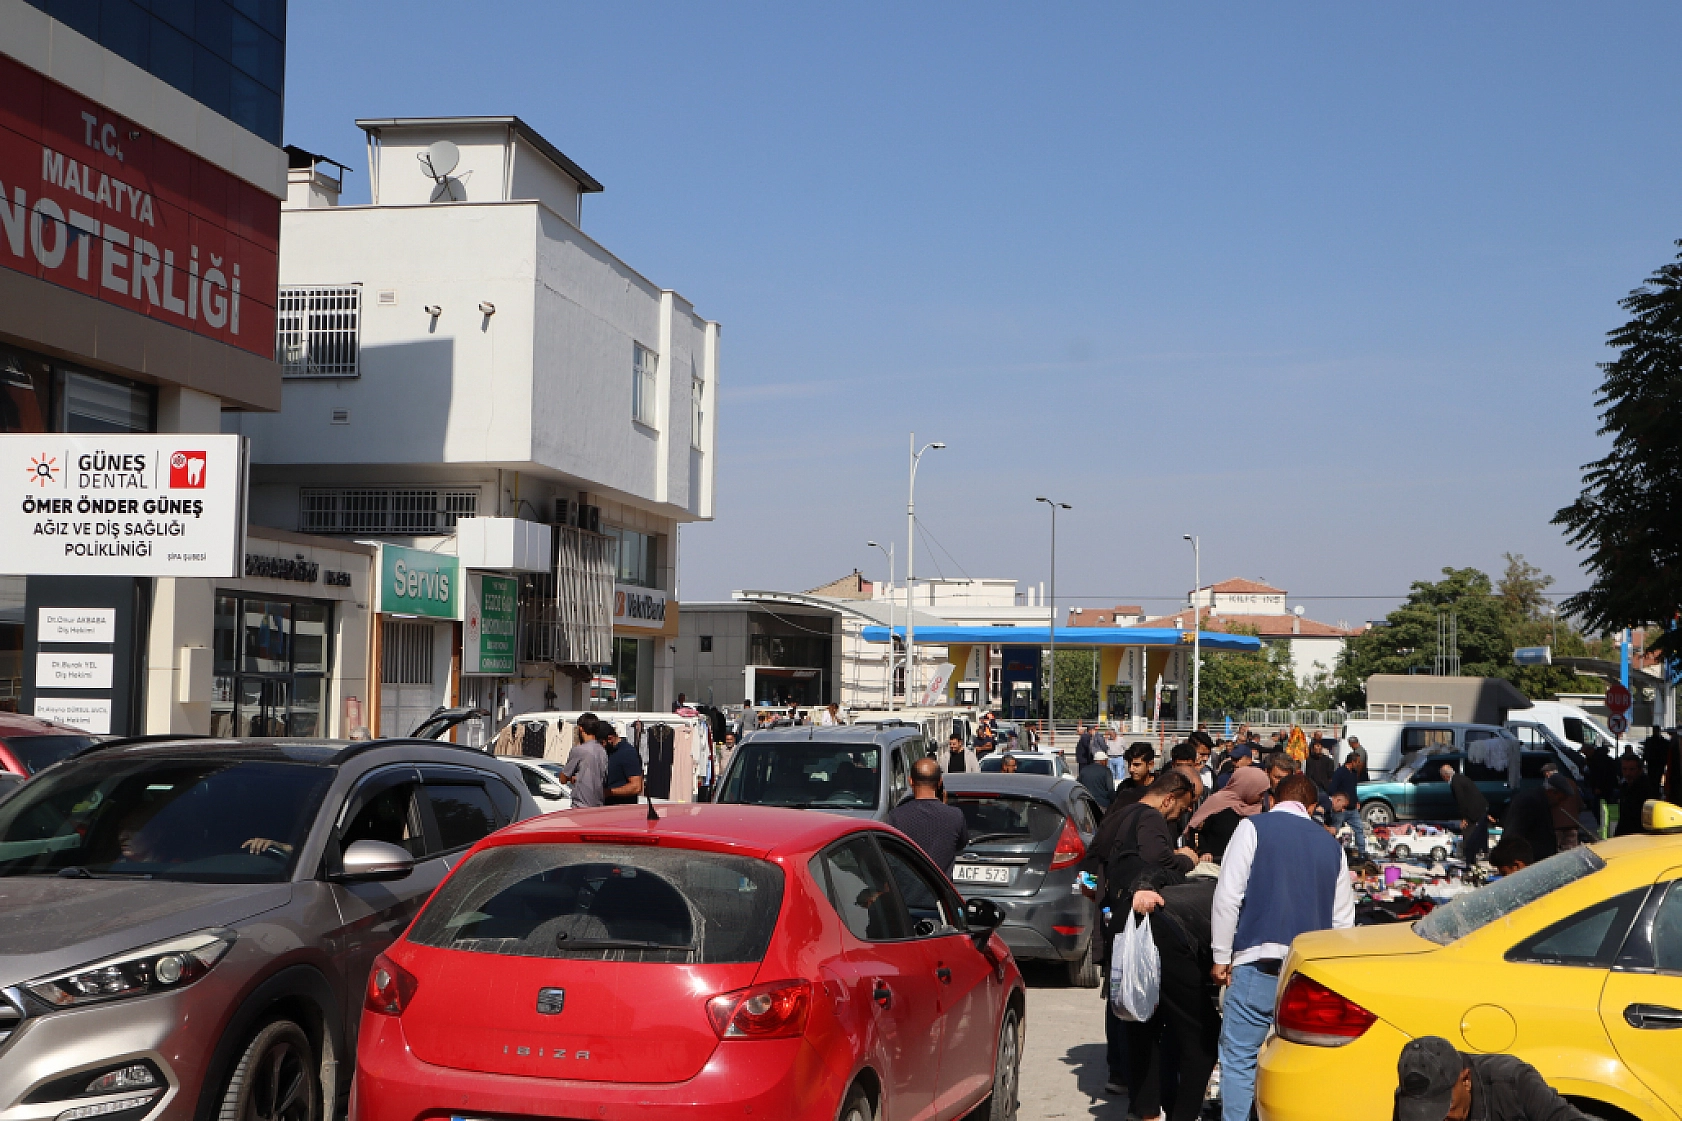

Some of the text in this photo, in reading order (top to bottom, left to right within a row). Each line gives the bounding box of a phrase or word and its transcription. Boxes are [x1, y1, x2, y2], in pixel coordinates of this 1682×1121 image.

[81, 111, 124, 162] T.C.
[42, 147, 155, 228] MALATYA
[78, 450, 147, 474] GÜNEŞ
[78, 474, 149, 489] DENTAL
[22, 495, 204, 518] ÖMER ÖNDER GÜNEŞ
[33, 519, 186, 539] AĞIZ VE DİŞ SAĞLIĞI
[64, 541, 153, 557] POLİKLİNİĞİ
[393, 558, 449, 603] Servis
[1607, 692, 1629, 706] DUR
[957, 866, 1008, 881] ACF 573
[502, 1044, 591, 1061] IBIZA
